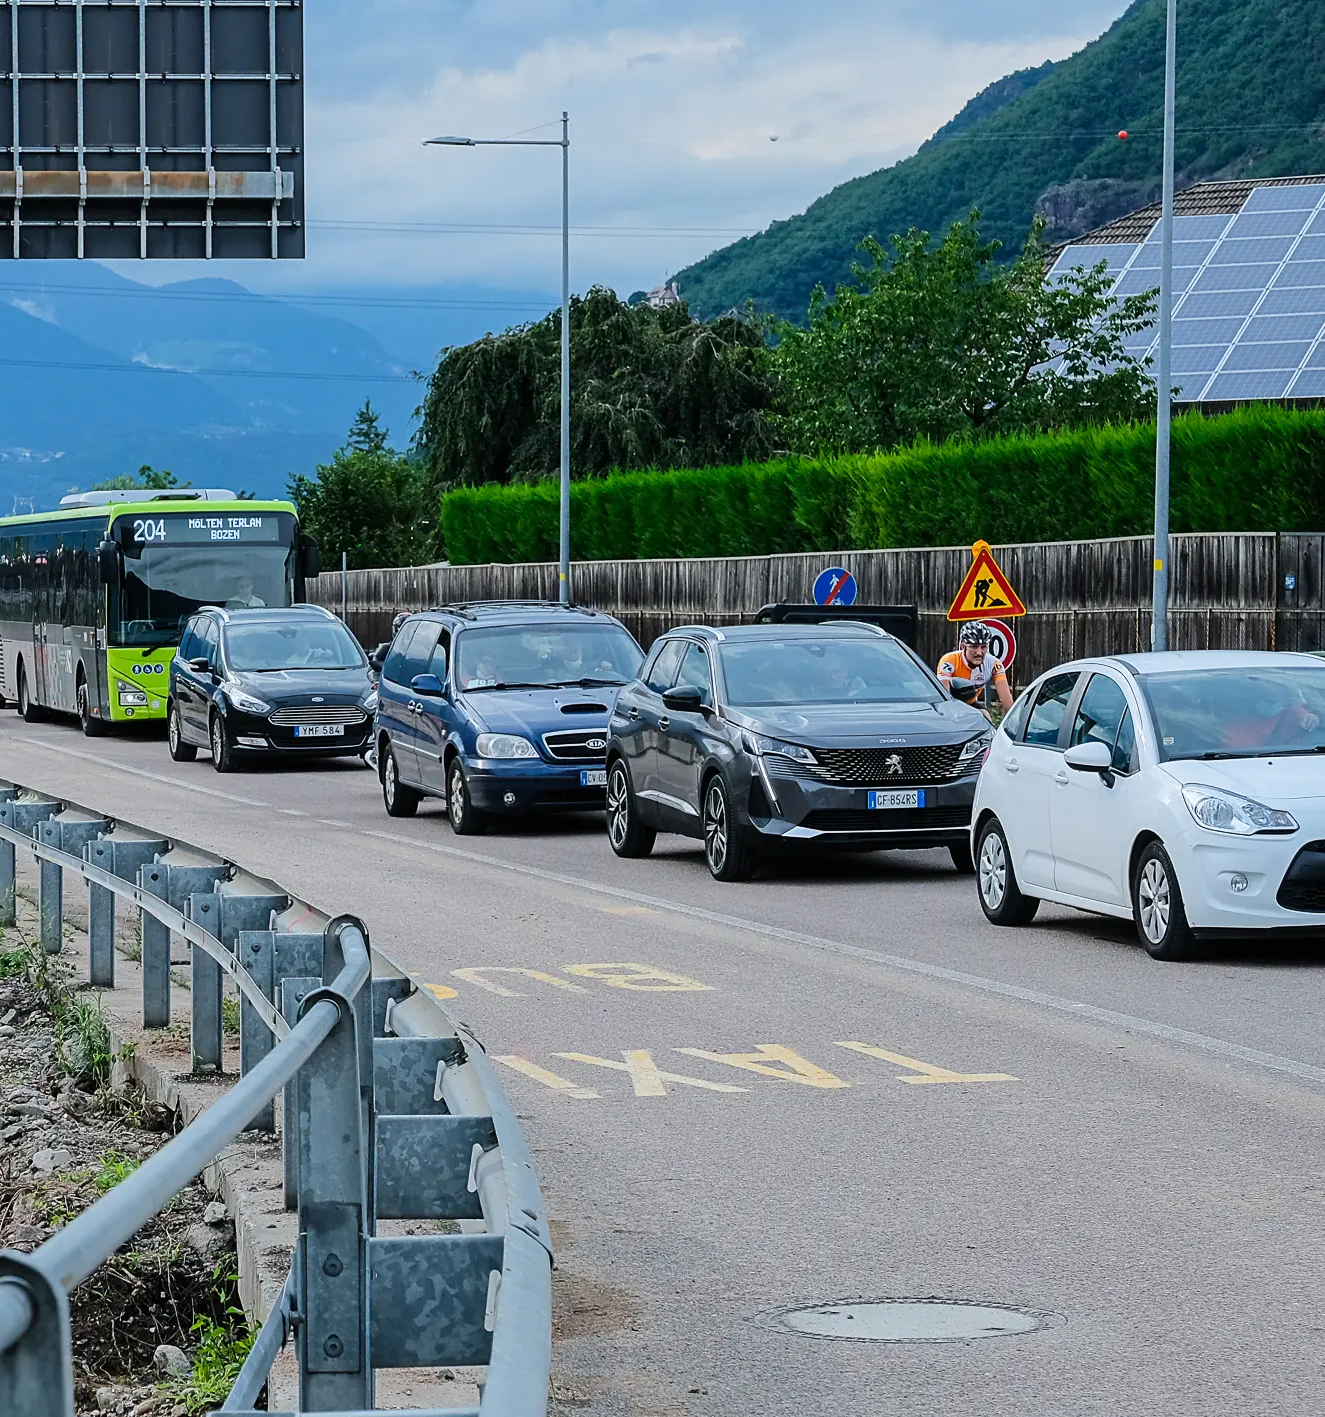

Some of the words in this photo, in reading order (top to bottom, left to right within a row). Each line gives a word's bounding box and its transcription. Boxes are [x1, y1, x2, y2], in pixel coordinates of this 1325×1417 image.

[228, 517, 262, 528] TERLAN
[133, 519, 167, 541] 204
[210, 529, 240, 540] BOZEN
[302, 726, 320, 736] YMF
[322, 726, 341, 735] 584
[489, 1041, 1021, 1099] TAXI
